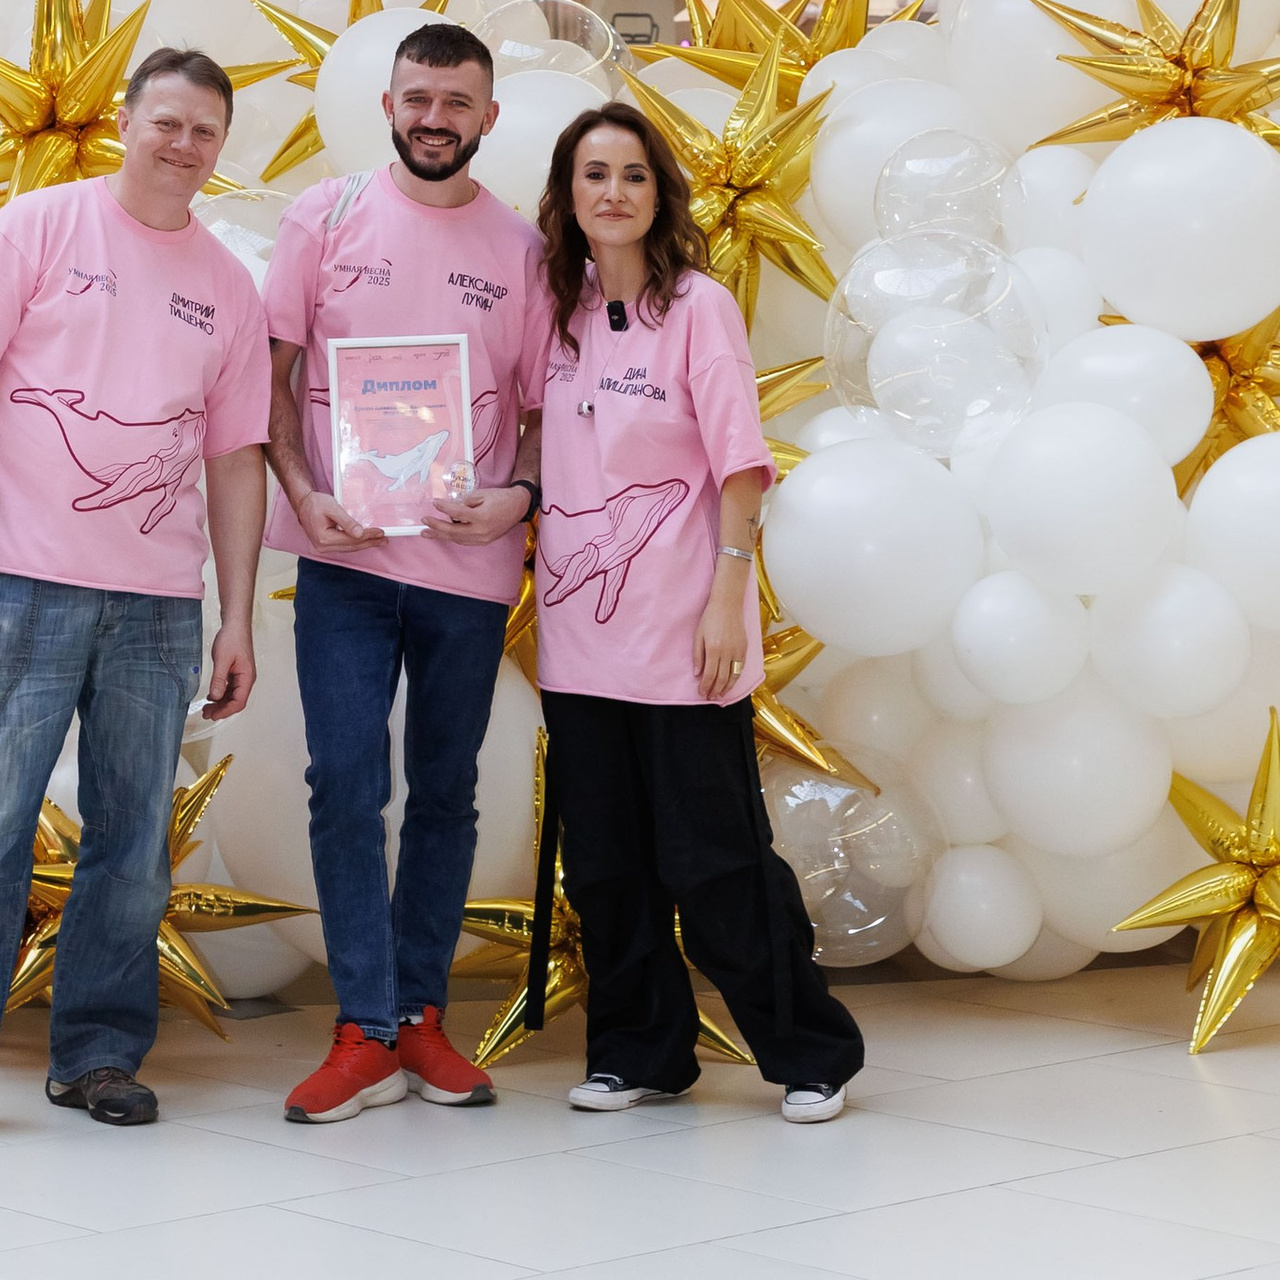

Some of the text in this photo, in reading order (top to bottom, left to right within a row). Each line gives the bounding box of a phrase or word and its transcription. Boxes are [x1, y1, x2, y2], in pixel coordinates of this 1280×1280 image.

[68, 267, 94, 282] УМНАЯ
[333, 263, 391, 277] УМНАЯ ВЕСНА
[367, 276, 391, 287] 2025
[447, 272, 508, 300] АЛЕКСАНДР
[100, 283, 117, 297] 2025
[171, 292, 216, 320] ДМИТРИЙ
[461, 292, 494, 312] ЛУКИН
[169, 303, 215, 336] ТИЩЕНКО
[623, 367, 647, 381] ДИНА
[361, 379, 437, 395] Диплом
